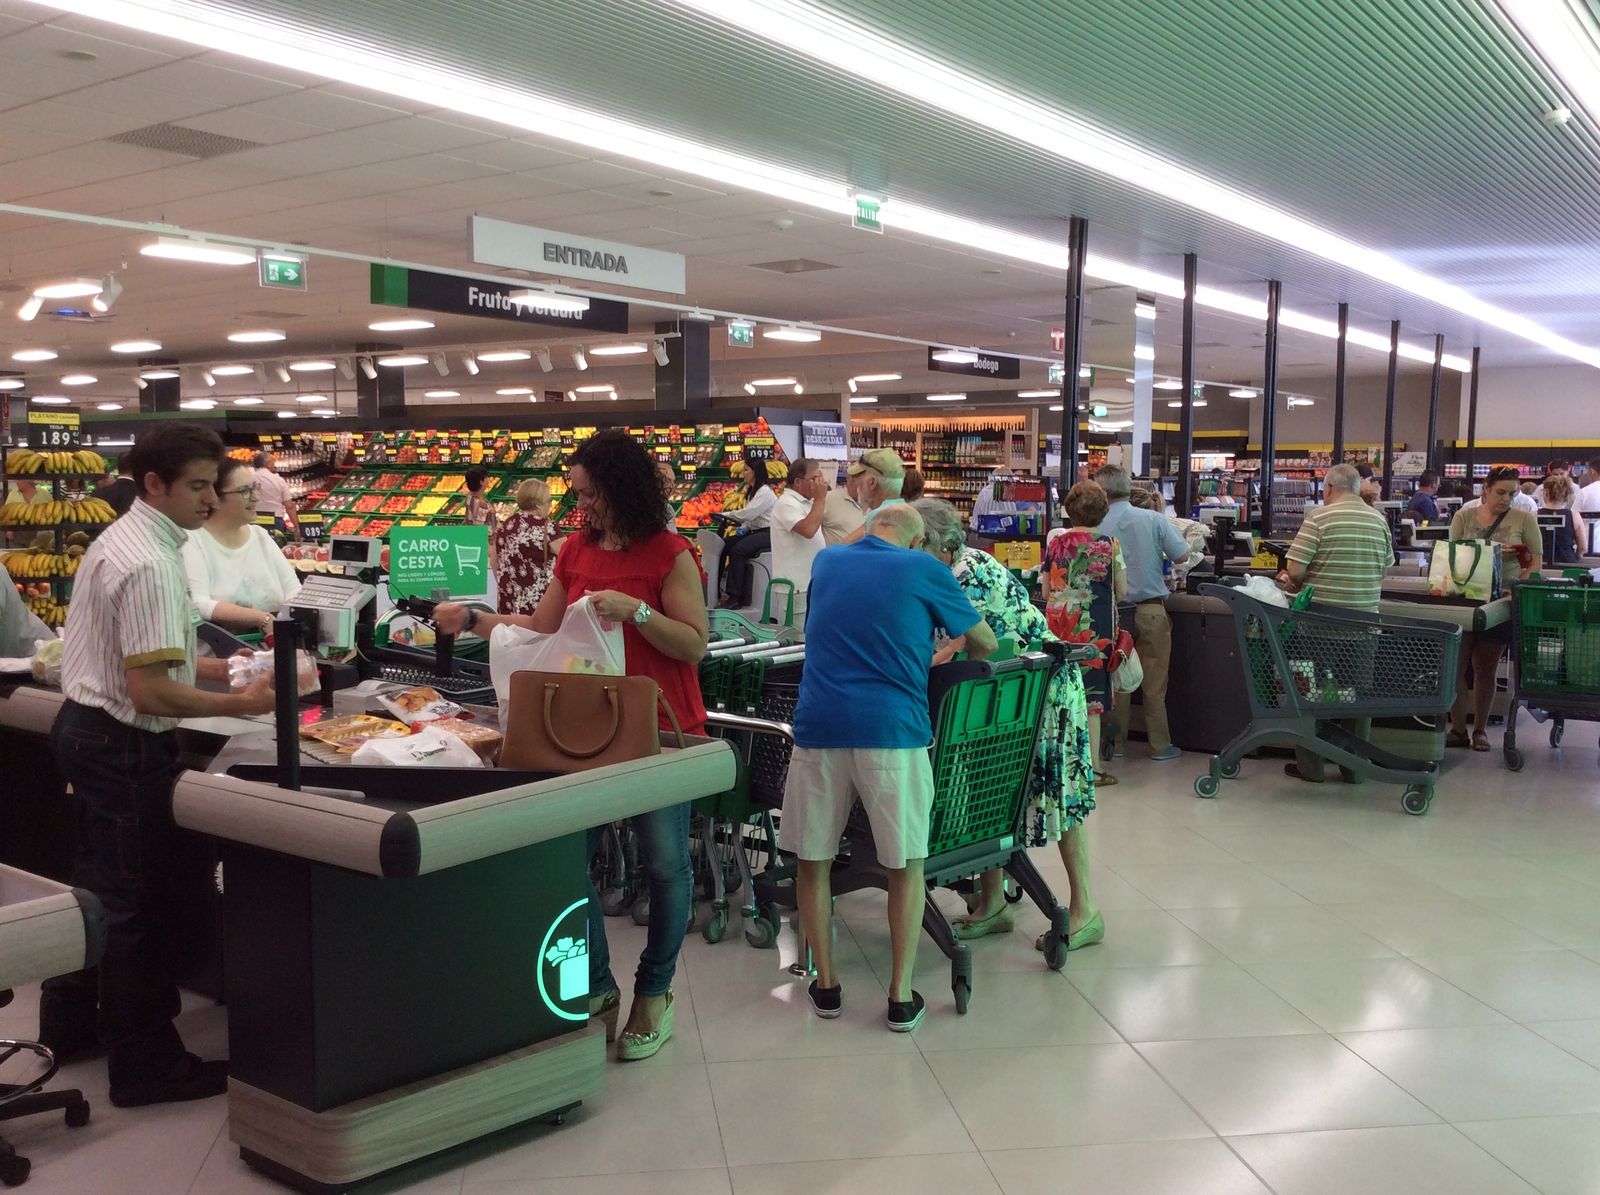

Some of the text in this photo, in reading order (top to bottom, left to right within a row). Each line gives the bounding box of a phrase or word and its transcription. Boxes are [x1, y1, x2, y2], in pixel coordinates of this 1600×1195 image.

[543, 242, 628, 274] ENTRADA
[469, 287, 511, 310] Fruta
[973, 357, 999, 374] Bodega
[42, 432, 70, 445] 189
[805, 435, 844, 445] DESECADAS
[751, 450, 769, 459] 099
[399, 539, 449, 552] CARRO
[399, 555, 443, 569] CESTA
